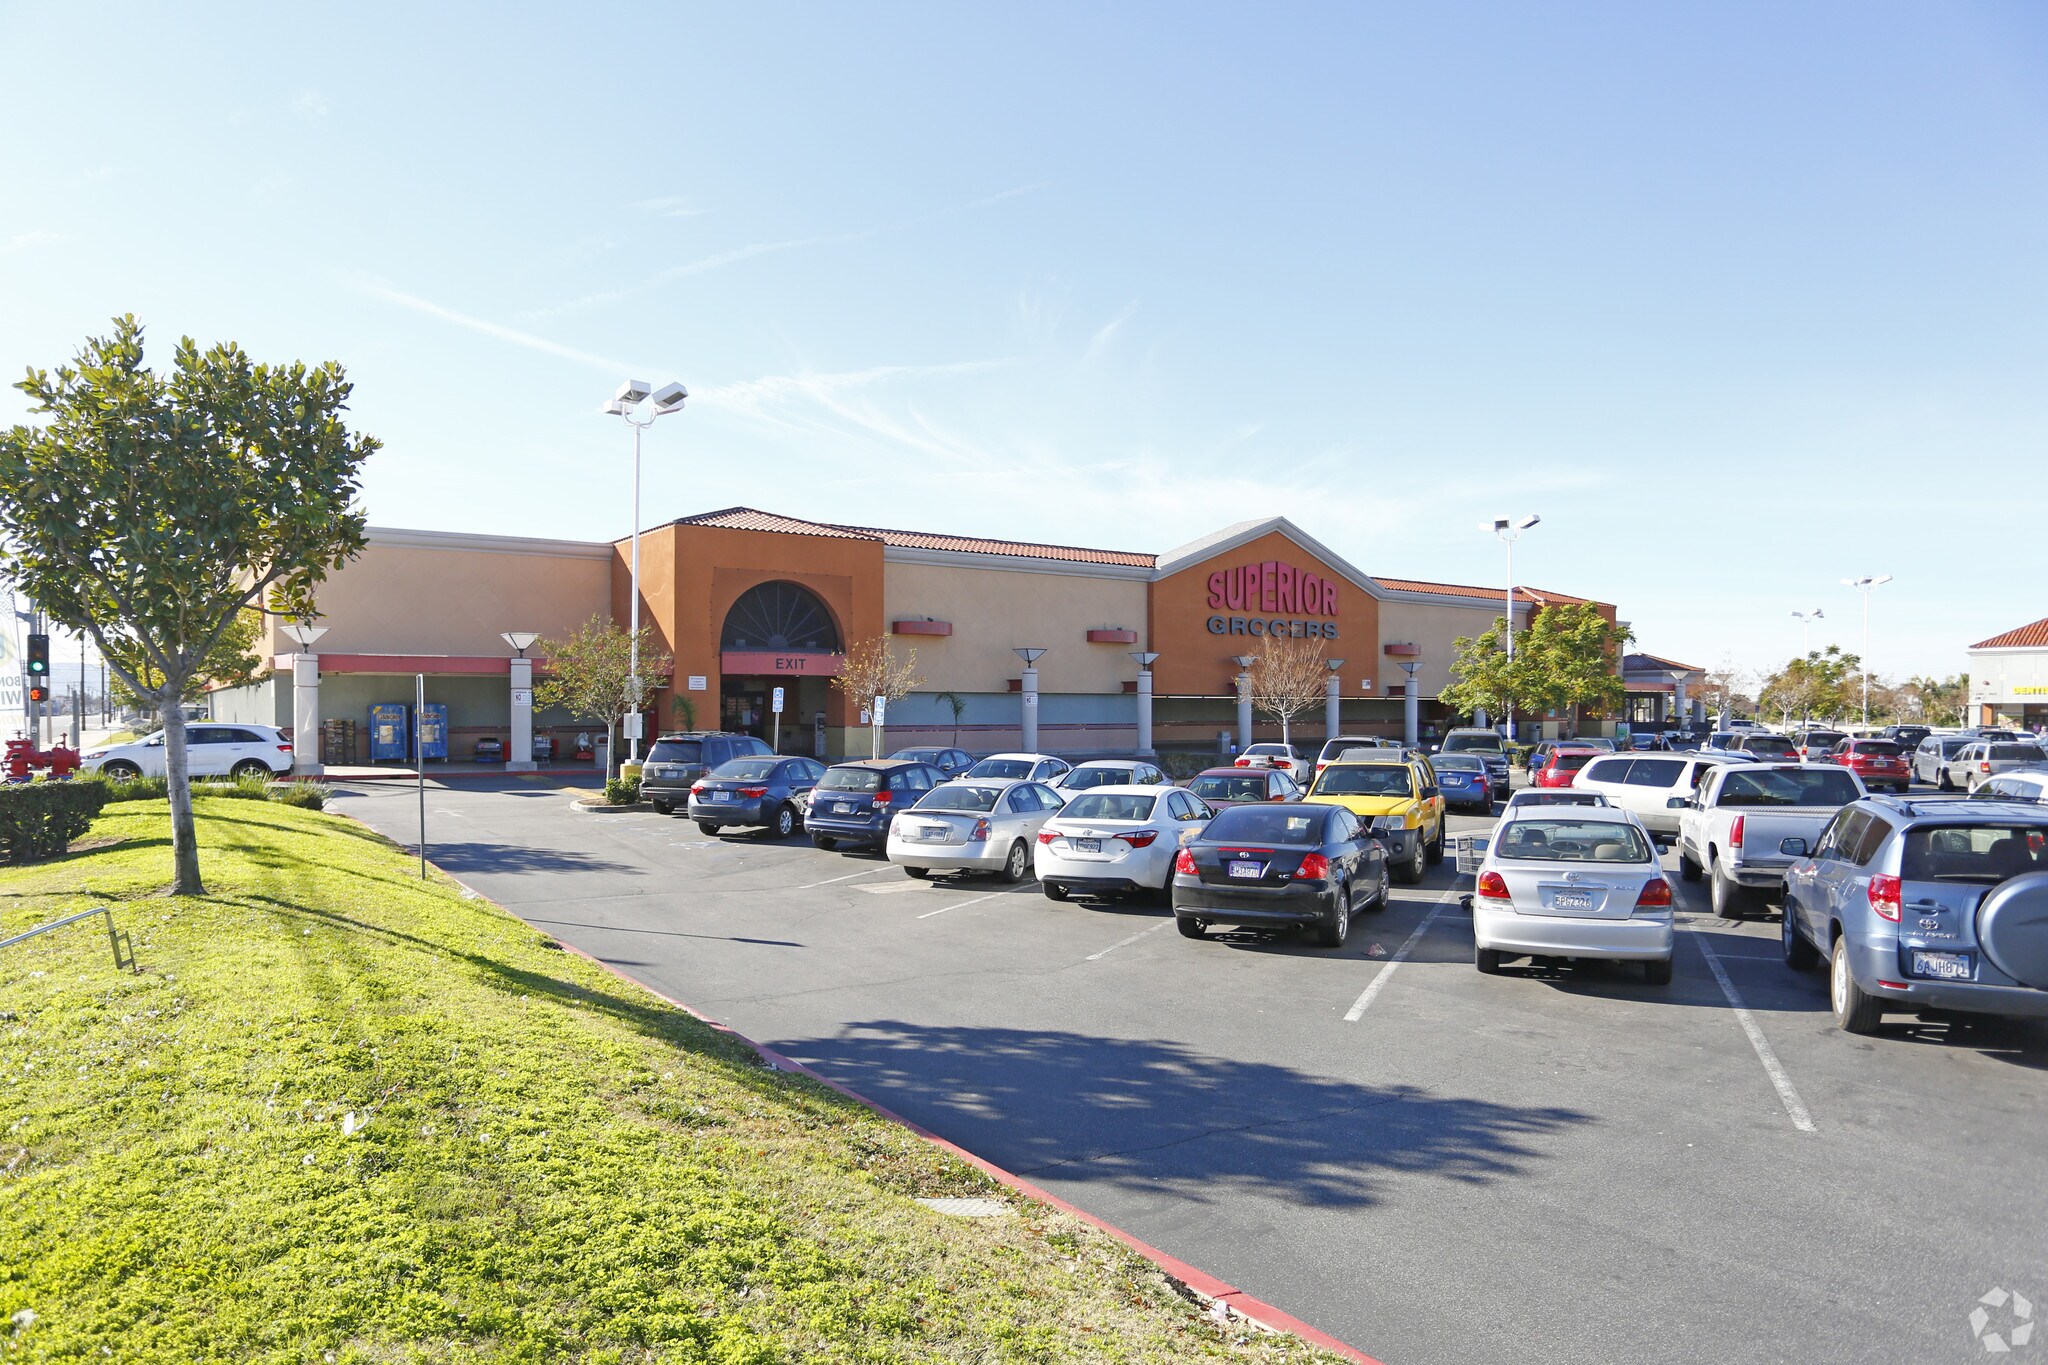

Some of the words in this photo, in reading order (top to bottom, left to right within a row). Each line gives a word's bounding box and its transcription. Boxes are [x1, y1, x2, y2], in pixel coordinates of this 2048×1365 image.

[1207, 560, 1339, 616] SUPERIOR
[1206, 615, 1339, 639] GROCERS
[776, 658, 807, 670] EXIT
[1555, 896, 1591, 907] 5PGZ326
[1916, 959, 1967, 975] 6AJH871
